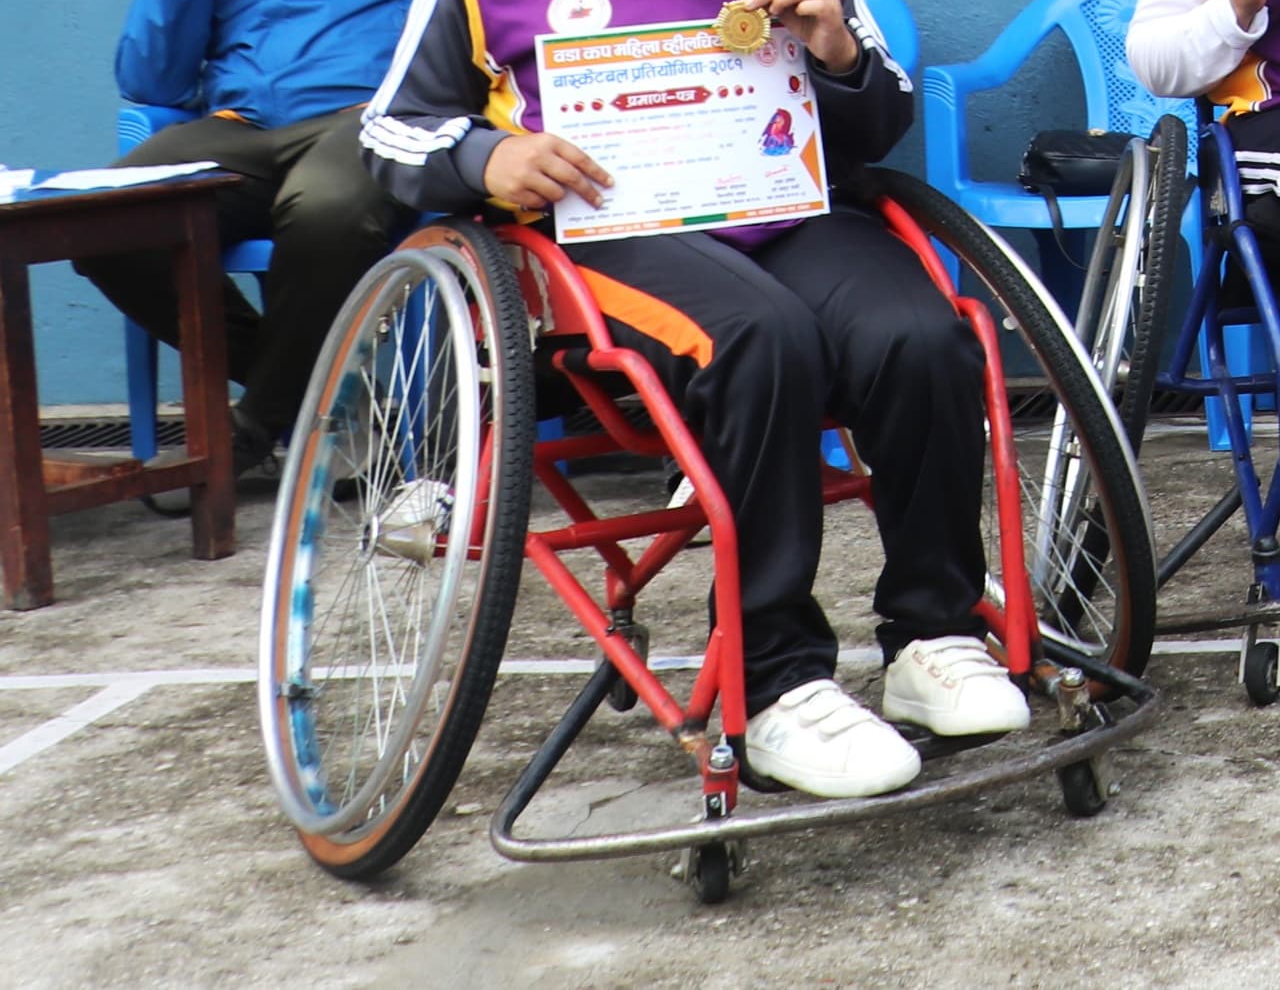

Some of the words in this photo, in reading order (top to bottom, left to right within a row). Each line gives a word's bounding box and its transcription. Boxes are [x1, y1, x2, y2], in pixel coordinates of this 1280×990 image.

[553, 47, 580, 63] वडा
[583, 45, 611, 60] कप
[614, 37, 660, 58] महिला
[553, 69, 629, 89] बास्केटबल
[627, 89, 697, 108] प्रमाण-पत्र
